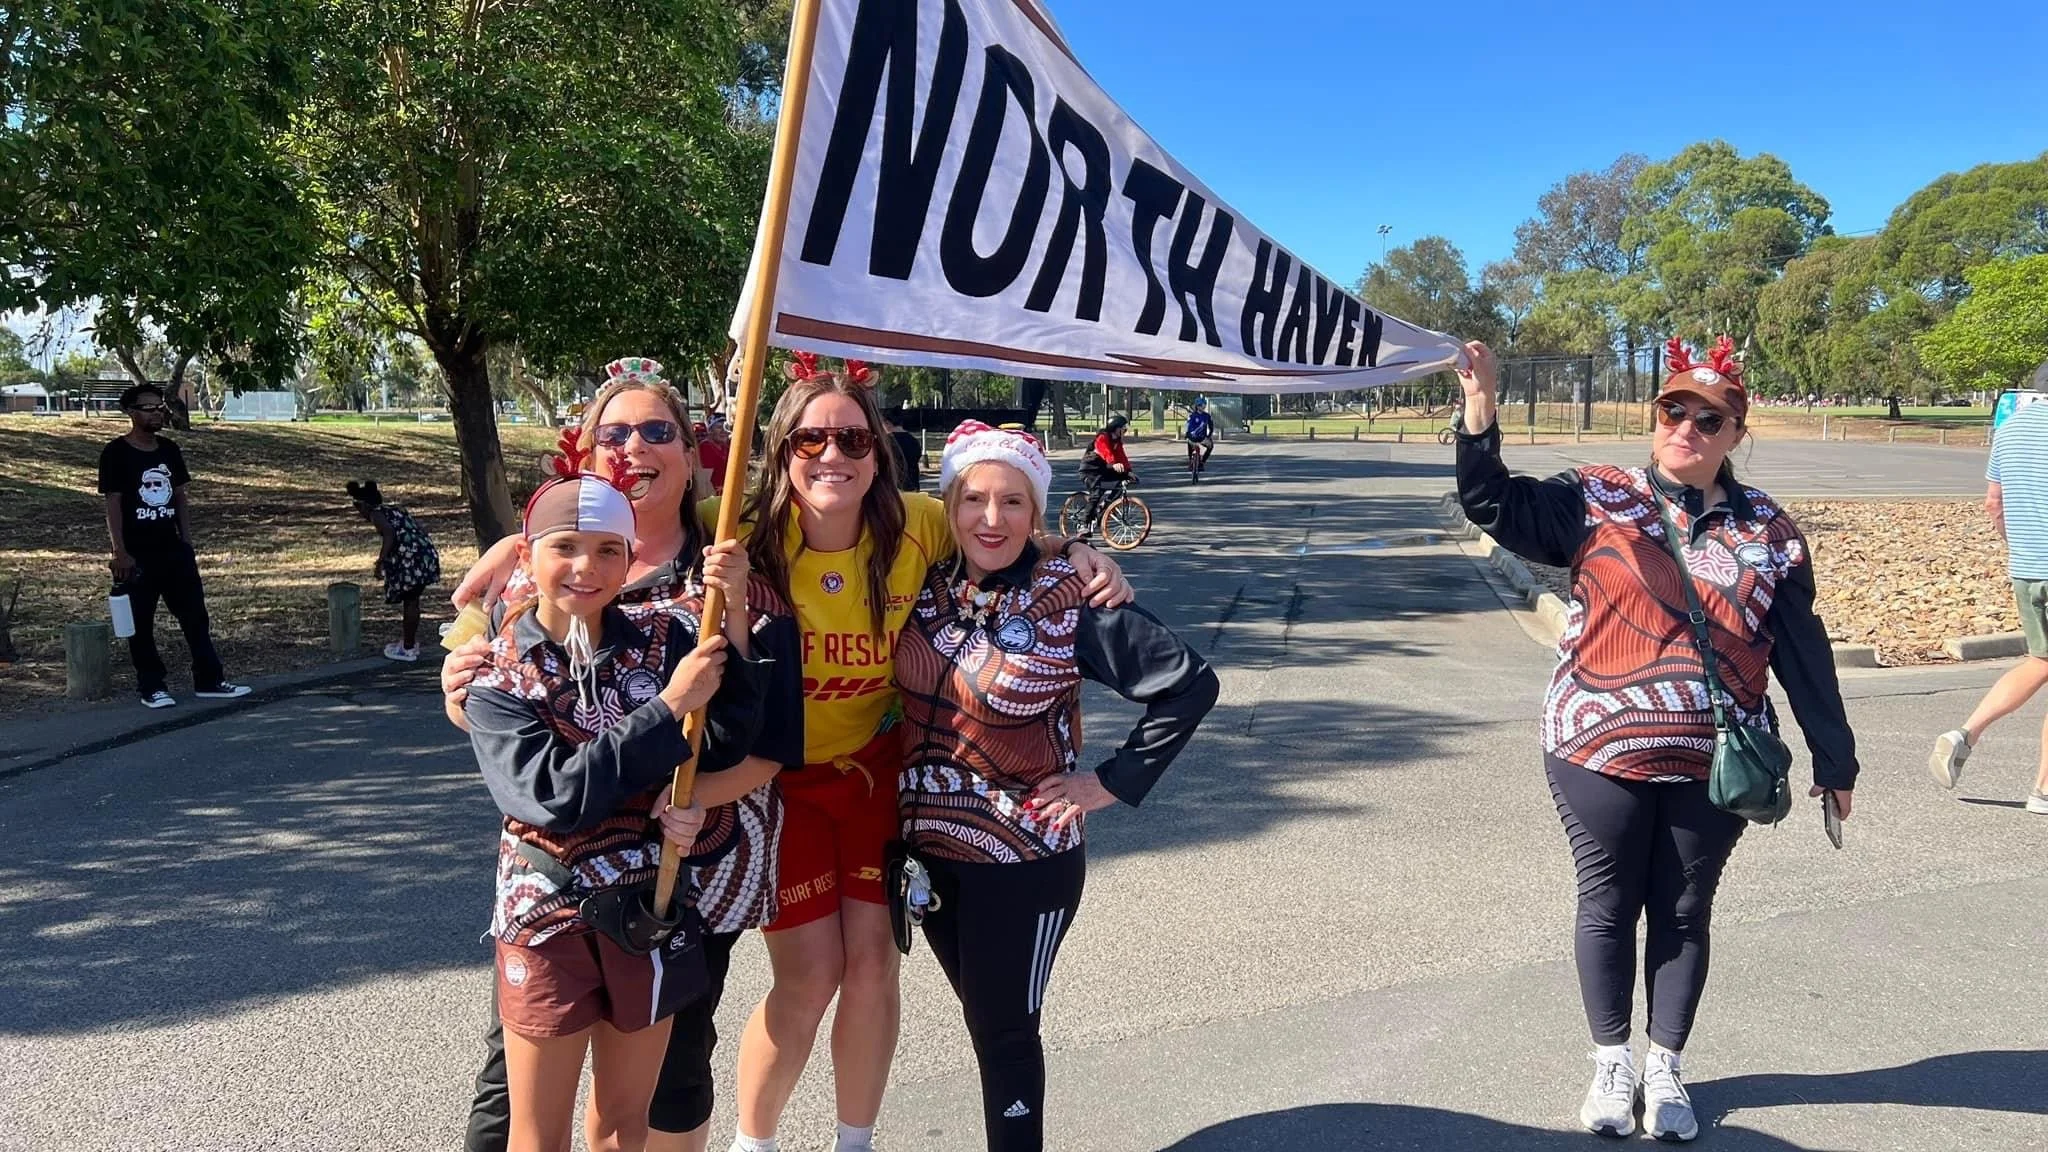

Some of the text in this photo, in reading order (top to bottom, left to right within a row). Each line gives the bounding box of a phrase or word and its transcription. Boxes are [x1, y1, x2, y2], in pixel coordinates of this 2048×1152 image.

[800, 0, 1383, 367] NORTH HAVEN
[780, 881, 812, 906] SURF
